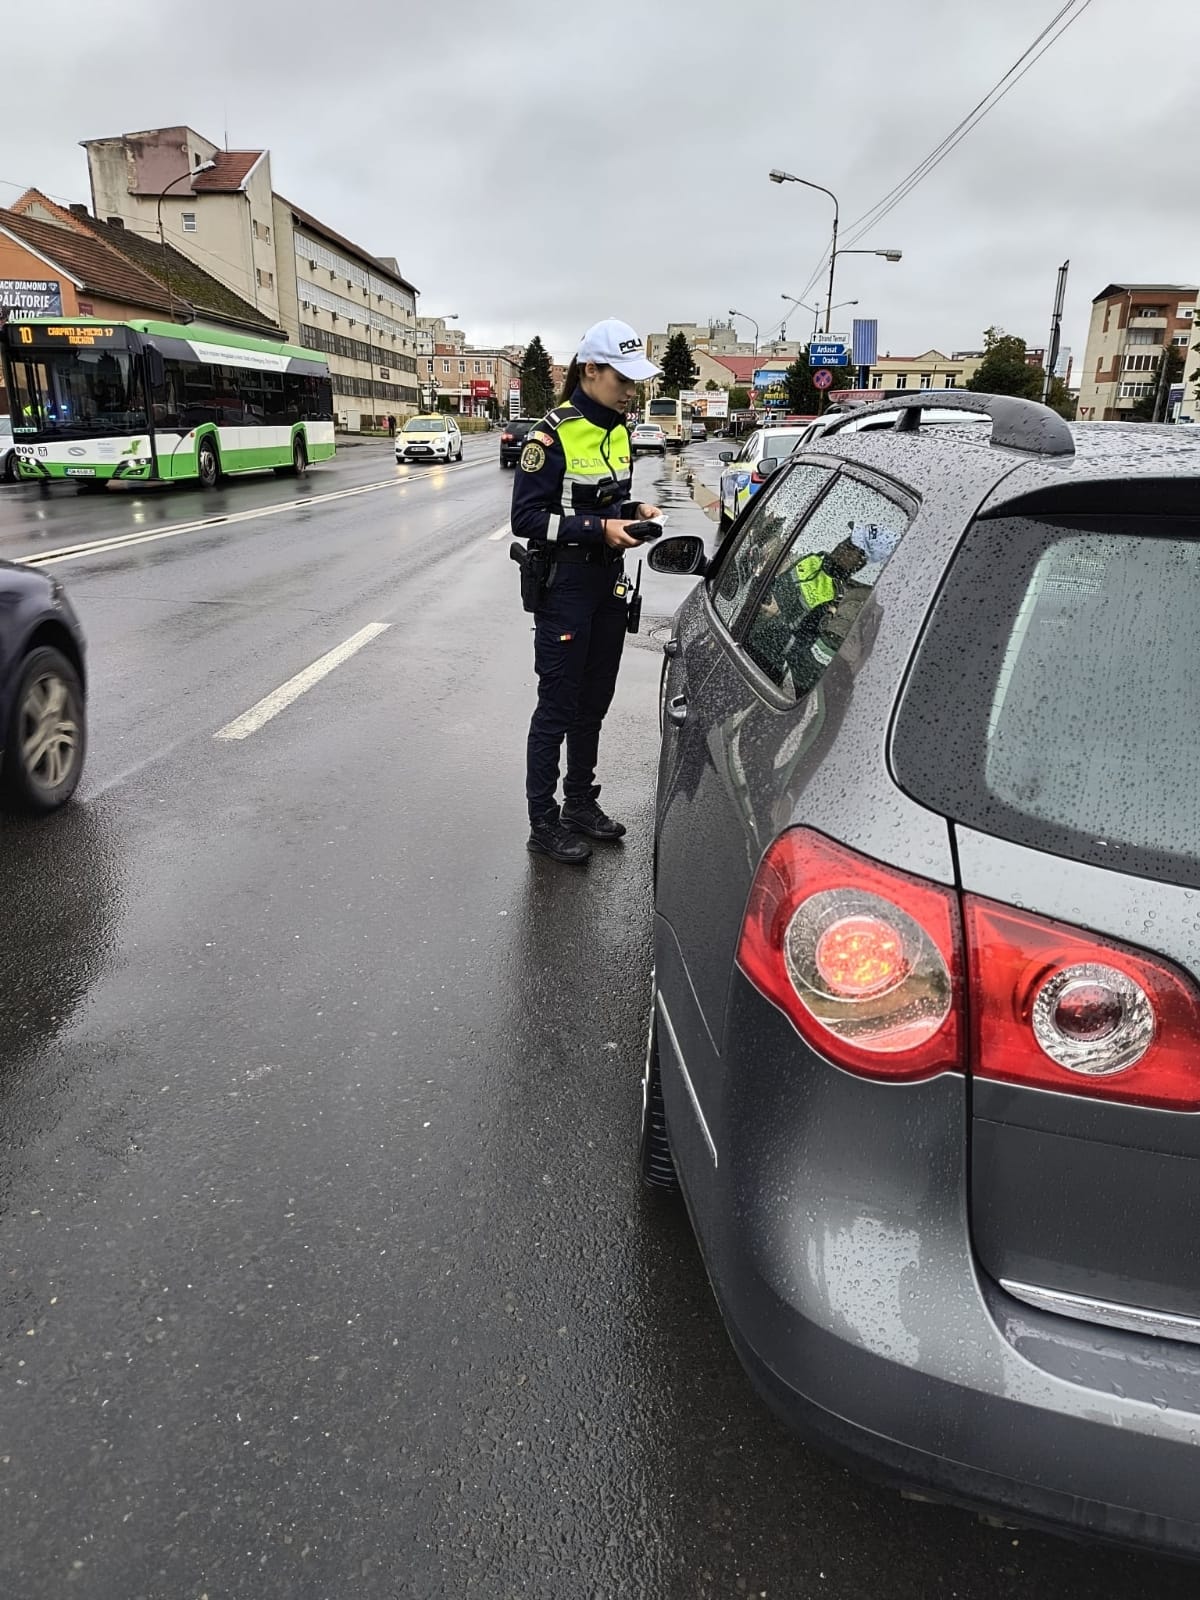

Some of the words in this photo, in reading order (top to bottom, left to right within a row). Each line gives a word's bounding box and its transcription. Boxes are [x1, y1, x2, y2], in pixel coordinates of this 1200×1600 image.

[15, 281, 48, 291] DIAMOND
[19, 327, 33, 344] 10
[104, 328, 114, 336] 17
